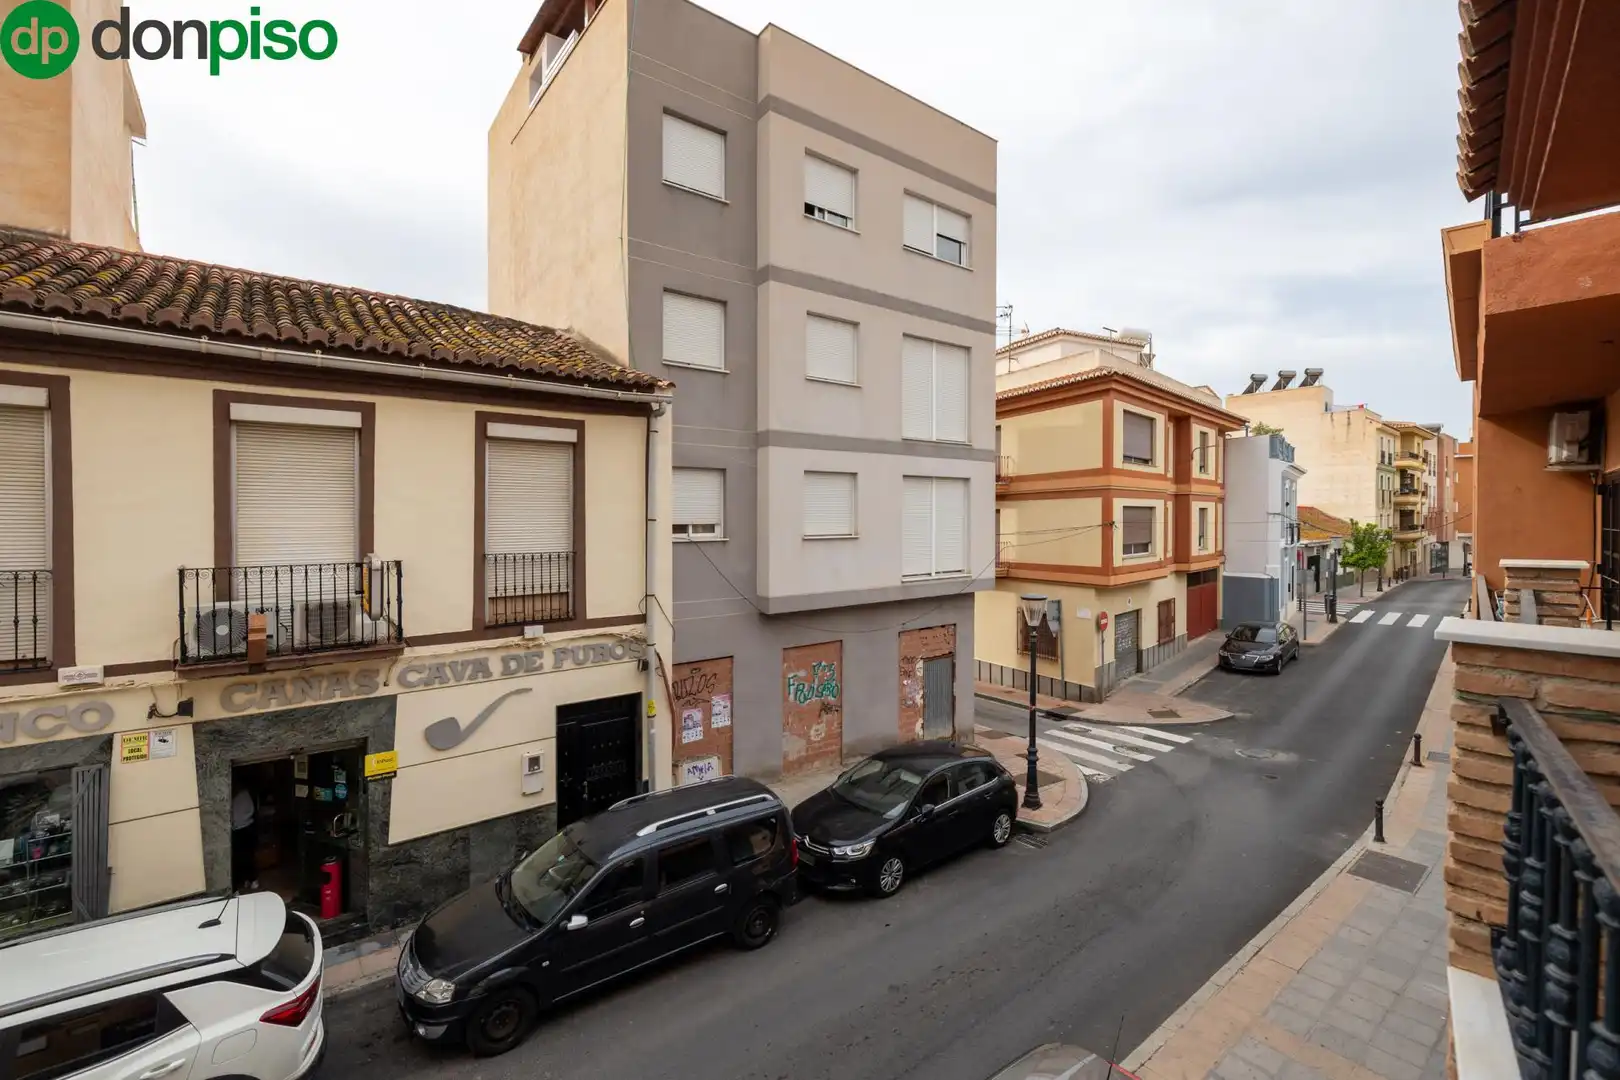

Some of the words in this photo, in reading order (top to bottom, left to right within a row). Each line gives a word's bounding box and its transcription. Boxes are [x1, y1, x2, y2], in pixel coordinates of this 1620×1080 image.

[397, 657, 493, 689] CAVA
[501, 650, 544, 676] DE
[552, 639, 648, 668] PUROS
